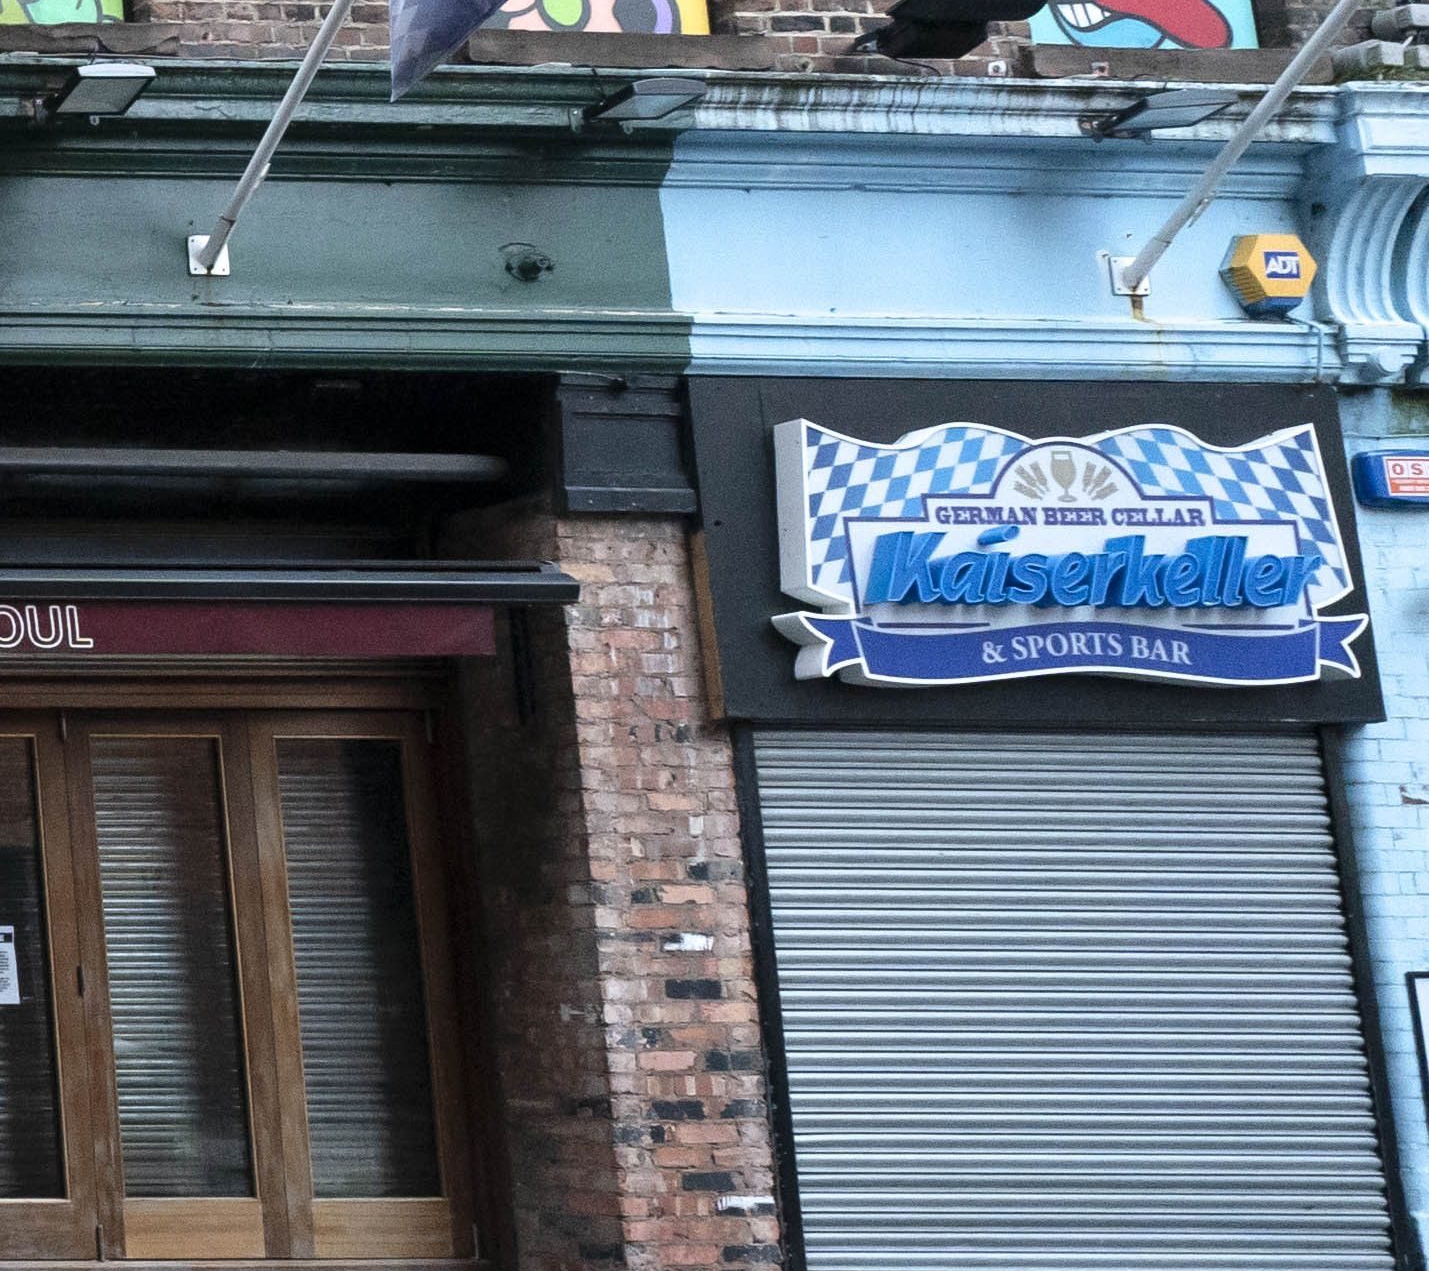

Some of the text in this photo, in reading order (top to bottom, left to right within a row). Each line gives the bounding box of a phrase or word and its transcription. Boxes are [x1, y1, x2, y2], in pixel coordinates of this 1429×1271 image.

[1265, 255, 1300, 275] ADT
[934, 505, 1207, 527] GERMAN BEER CELLAR
[866, 525, 1319, 609] Kaiserkeller
[982, 632, 1192, 665] & SPORTS BAR
